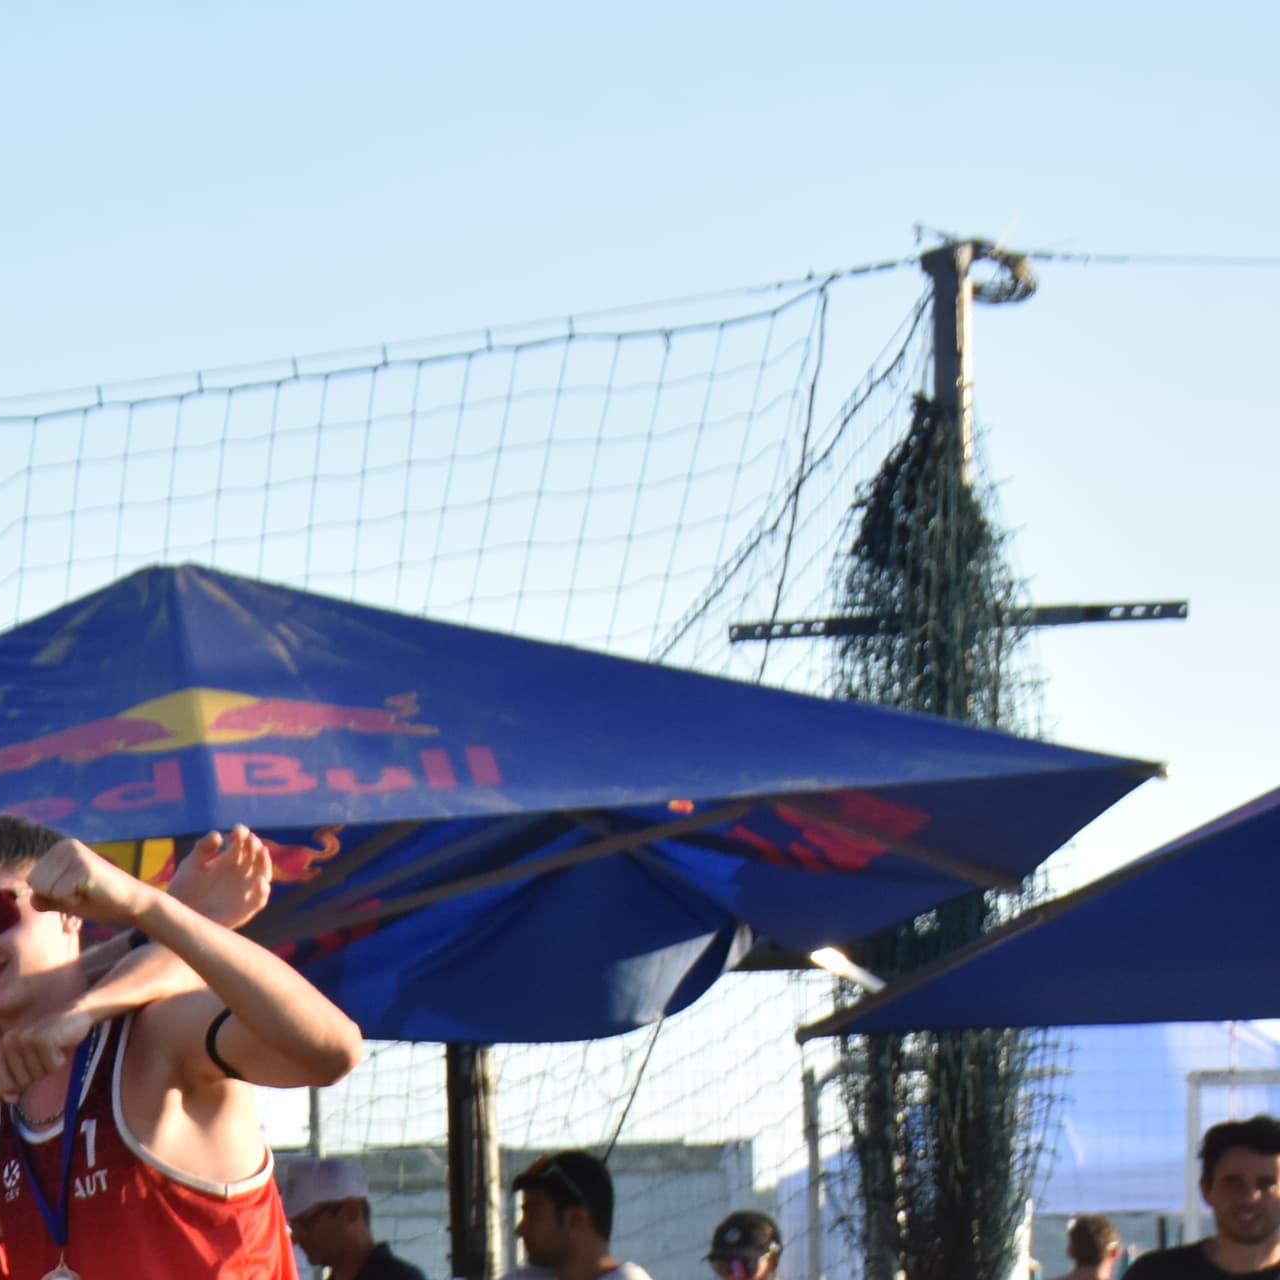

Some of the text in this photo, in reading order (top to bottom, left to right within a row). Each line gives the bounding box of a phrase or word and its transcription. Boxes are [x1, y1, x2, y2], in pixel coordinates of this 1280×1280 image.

[214, 746, 503, 797] Bull
[80, 1119, 97, 1168] 1
[74, 1168, 108, 1198] AUT
